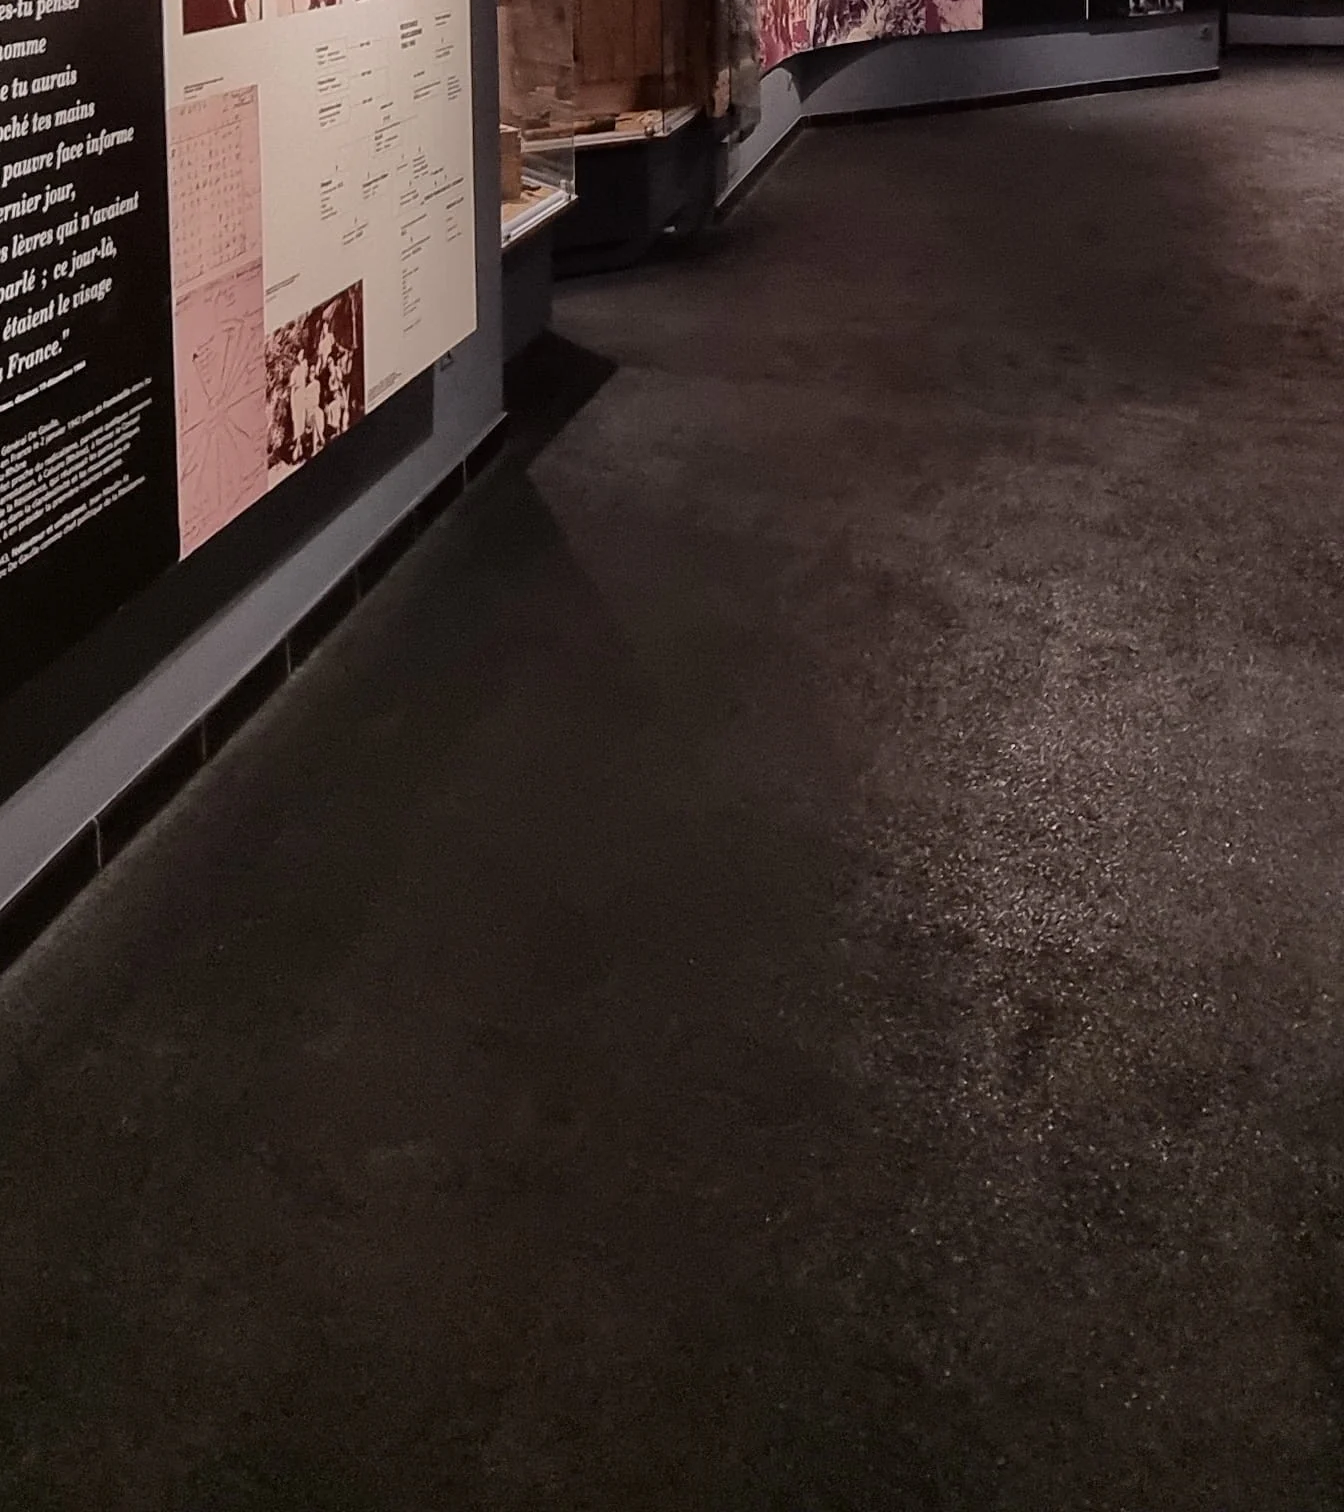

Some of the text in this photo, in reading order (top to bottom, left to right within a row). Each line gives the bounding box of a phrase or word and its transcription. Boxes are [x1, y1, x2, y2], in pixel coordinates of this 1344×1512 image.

[11, 77, 28, 98] tu
[32, 64, 78, 92] aurais
[32, 111, 52, 131] tes
[54, 99, 96, 127] mains
[1, 152, 54, 188] pauvre
[56, 141, 84, 170] face
[86, 126, 135, 156] informe
[42, 182, 76, 213] jour,
[11, 228, 54, 257] lèvres
[56, 216, 79, 242] qui
[81, 190, 139, 230] n'avaient
[53, 260, 68, 280] ce
[68, 236, 118, 278] jour-là,
[2, 299, 55, 341] étaient
[57, 293, 70, 316] le
[72, 277, 113, 309] visage
[6, 328, 70, 379] France."
